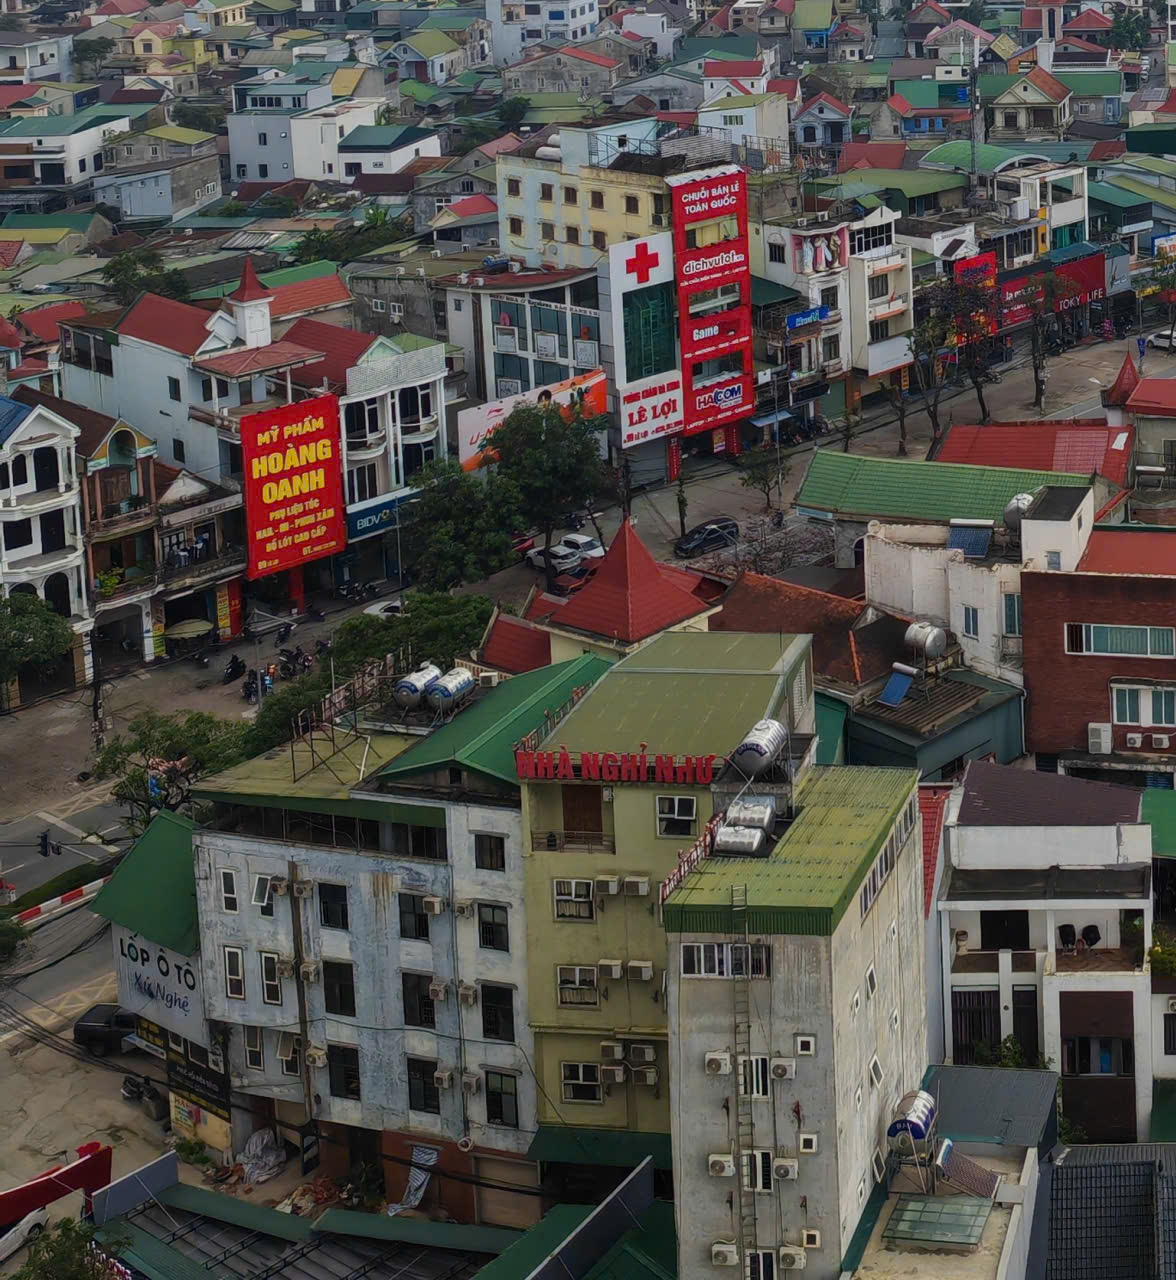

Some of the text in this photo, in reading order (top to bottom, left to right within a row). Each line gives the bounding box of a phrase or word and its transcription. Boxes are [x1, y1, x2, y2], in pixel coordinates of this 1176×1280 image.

[711, 184, 729, 197] BÁN
[684, 202, 709, 215] TOÀN
[693, 325, 719, 341] Game
[696, 384, 743, 410] HACOM
[628, 398, 678, 427] LÊ LỢI
[257, 425, 281, 447] MỸ
[251, 438, 333, 480] HOÀNG
[262, 468, 326, 505] OANH
[356, 513, 382, 531] BIDV
[516, 743, 575, 780] NHÀ
[581, 741, 649, 782] NGHỈ
[119, 932, 196, 991] LỐP Ô TÔ
[155, 982, 191, 1017] Nghệ
